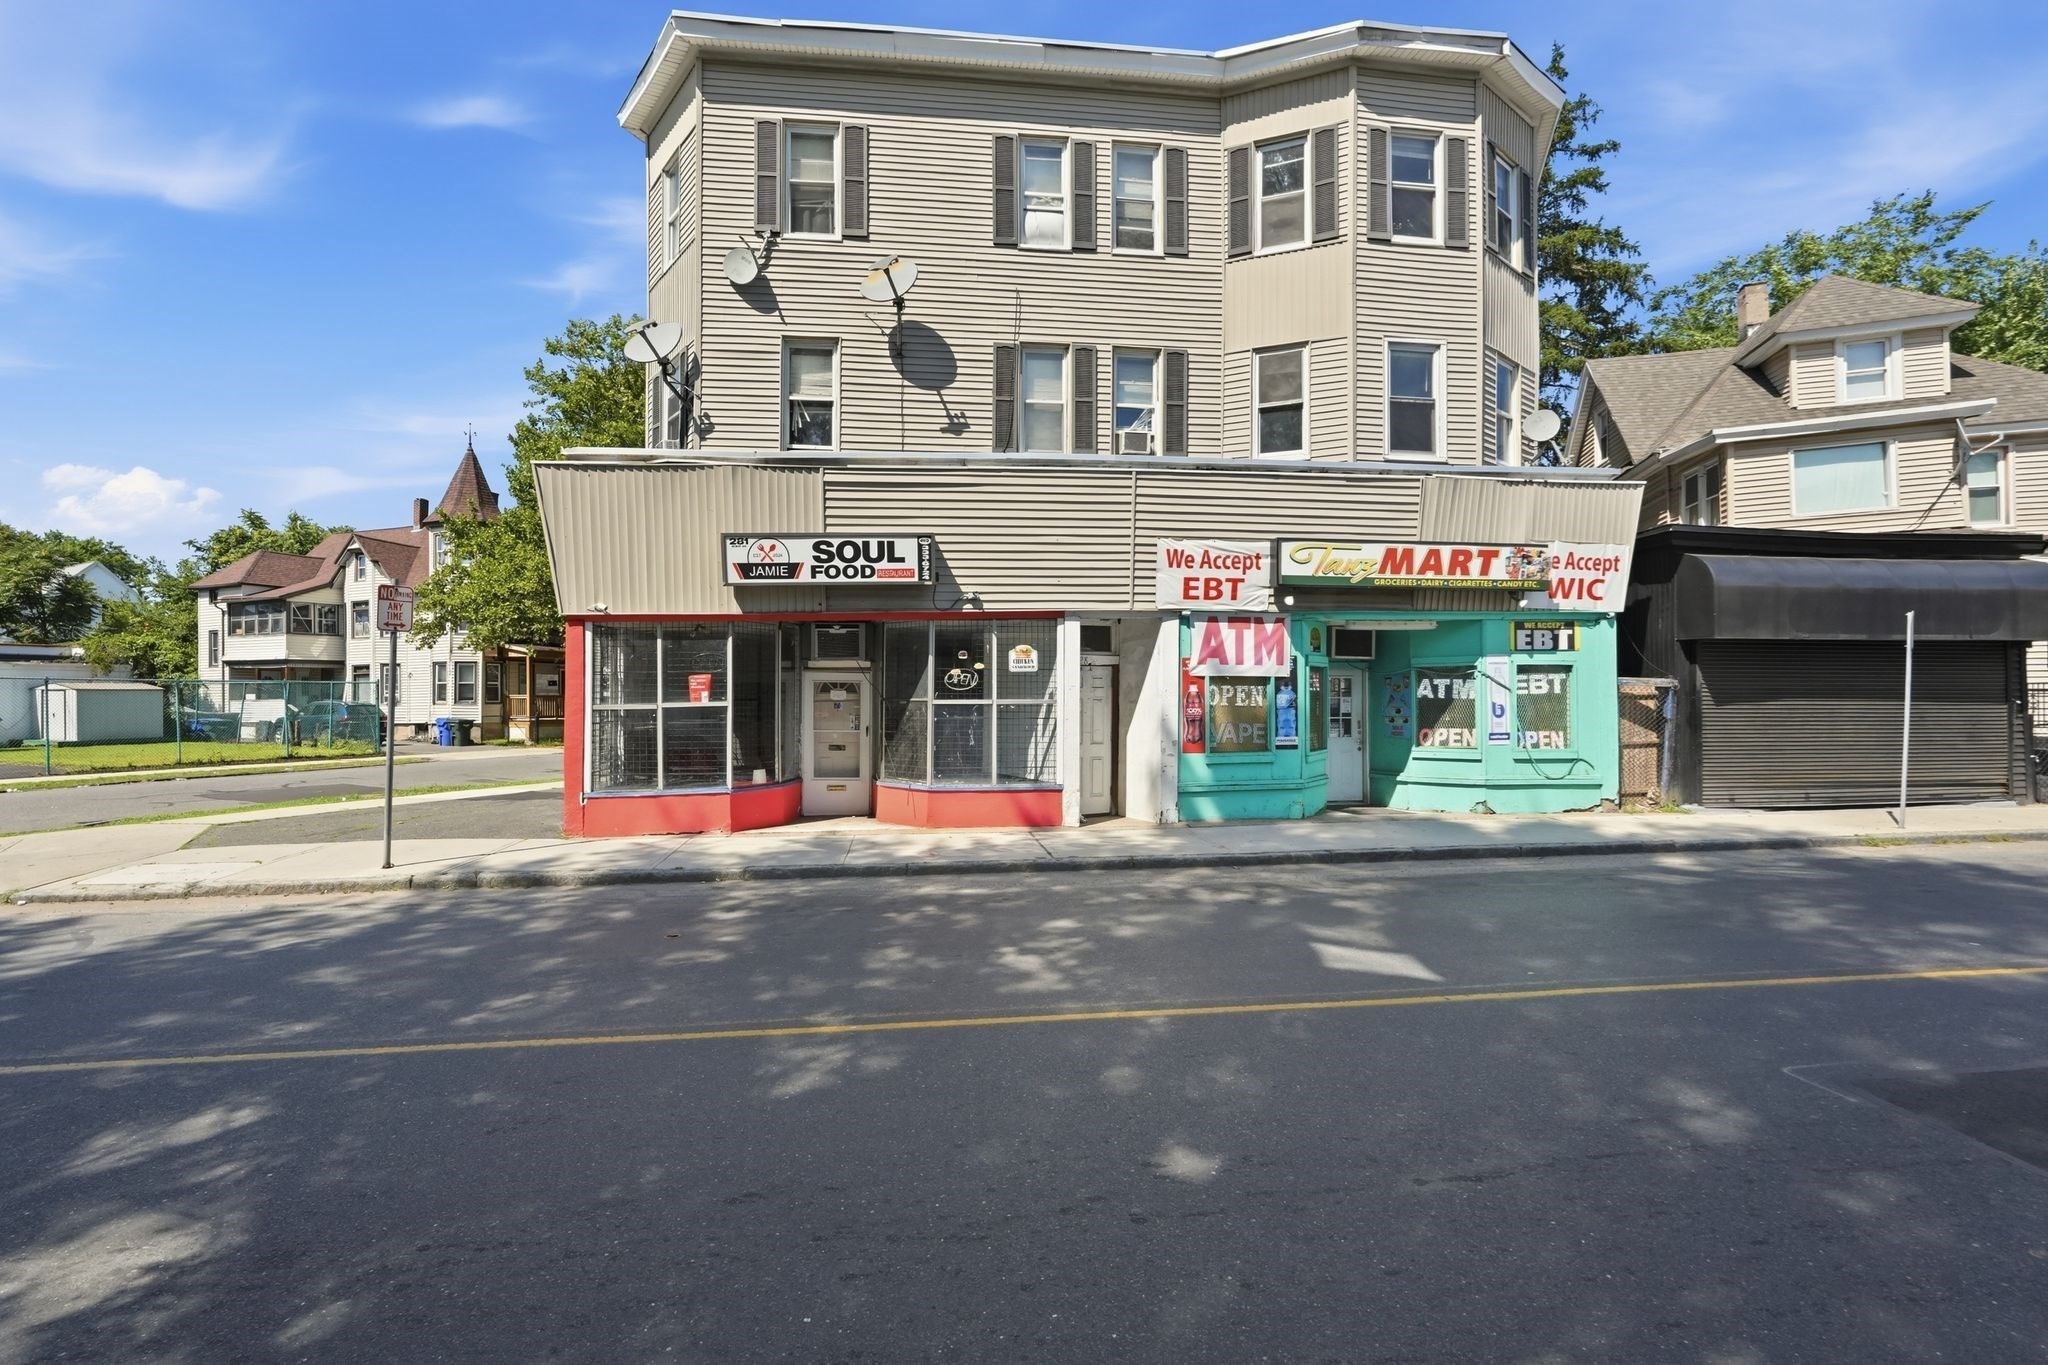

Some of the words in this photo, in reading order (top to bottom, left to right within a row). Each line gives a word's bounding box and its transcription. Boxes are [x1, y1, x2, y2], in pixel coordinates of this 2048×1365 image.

[729, 537, 749, 545] 281
[811, 540, 906, 564] SOUL
[1166, 548, 1195, 569] We
[1200, 549, 1262, 575] Accept
[749, 565, 789, 577] JAMIE
[810, 564, 876, 580] FOOD
[1289, 541, 1378, 584] Tanz
[1377, 547, 1500, 577] MART
[1551, 555, 1561, 570] e
[1564, 551, 1621, 577] Accept
[380, 587, 393, 599] NO
[1183, 577, 1245, 601] EBT
[1374, 578, 1417, 587] GROCERIES
[1448, 580, 1493, 588] CIGARETTES
[1548, 577, 1606, 601] WIC
[387, 602, 404, 611] ANY
[387, 611, 403, 621] TIME
[1197, 616, 1285, 666] ATM
[1517, 630, 1573, 650] EBT
[1417, 679, 1475, 699] ATM
[1517, 673, 1565, 694] EBT
[1210, 685, 1263, 706] OPEN
[1211, 722, 1266, 743] VAPE
[1419, 728, 1476, 747] OPEN
